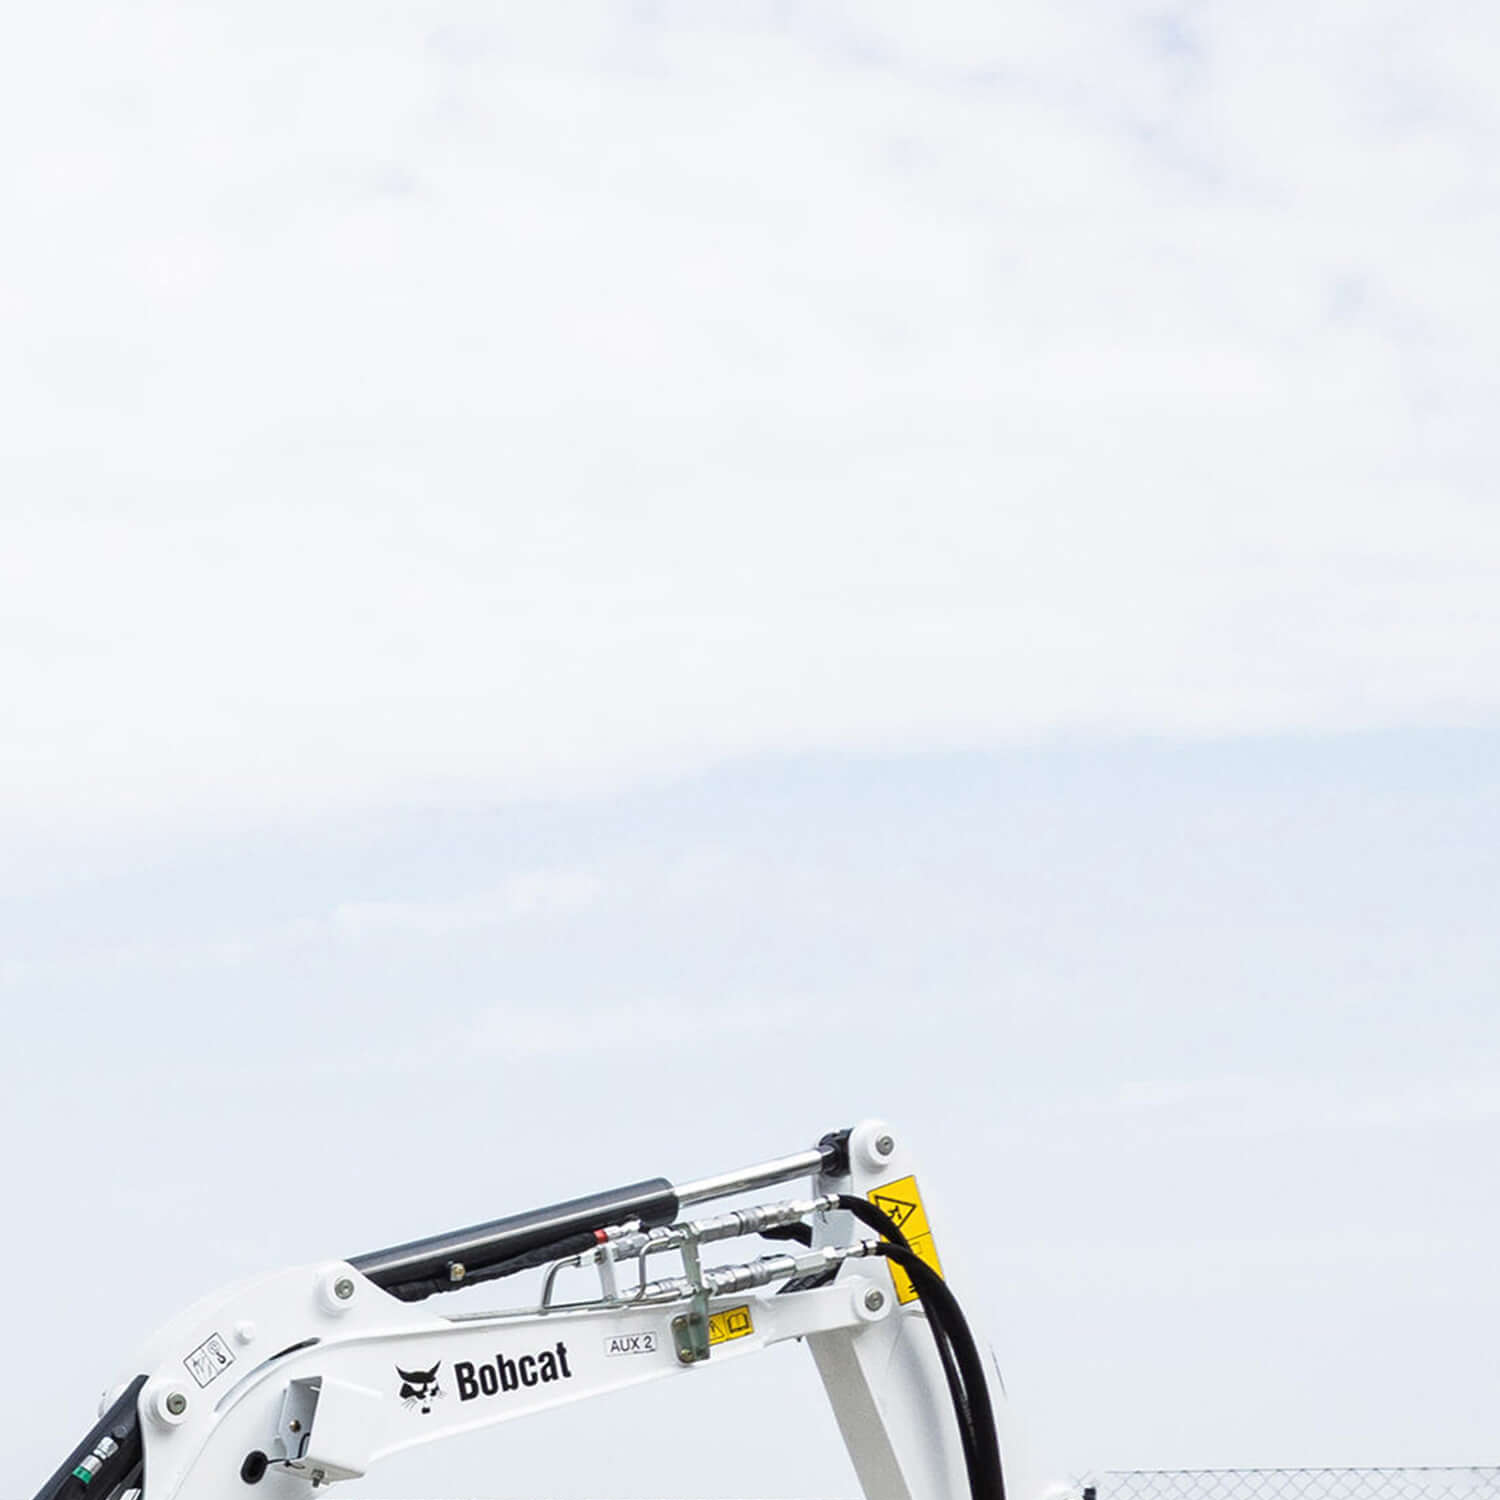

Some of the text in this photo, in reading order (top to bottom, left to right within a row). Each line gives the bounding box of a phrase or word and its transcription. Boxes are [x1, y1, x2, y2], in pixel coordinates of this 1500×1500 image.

[610, 1335, 653, 1353] AUX 2
[454, 1341, 572, 1401] Bobcat
